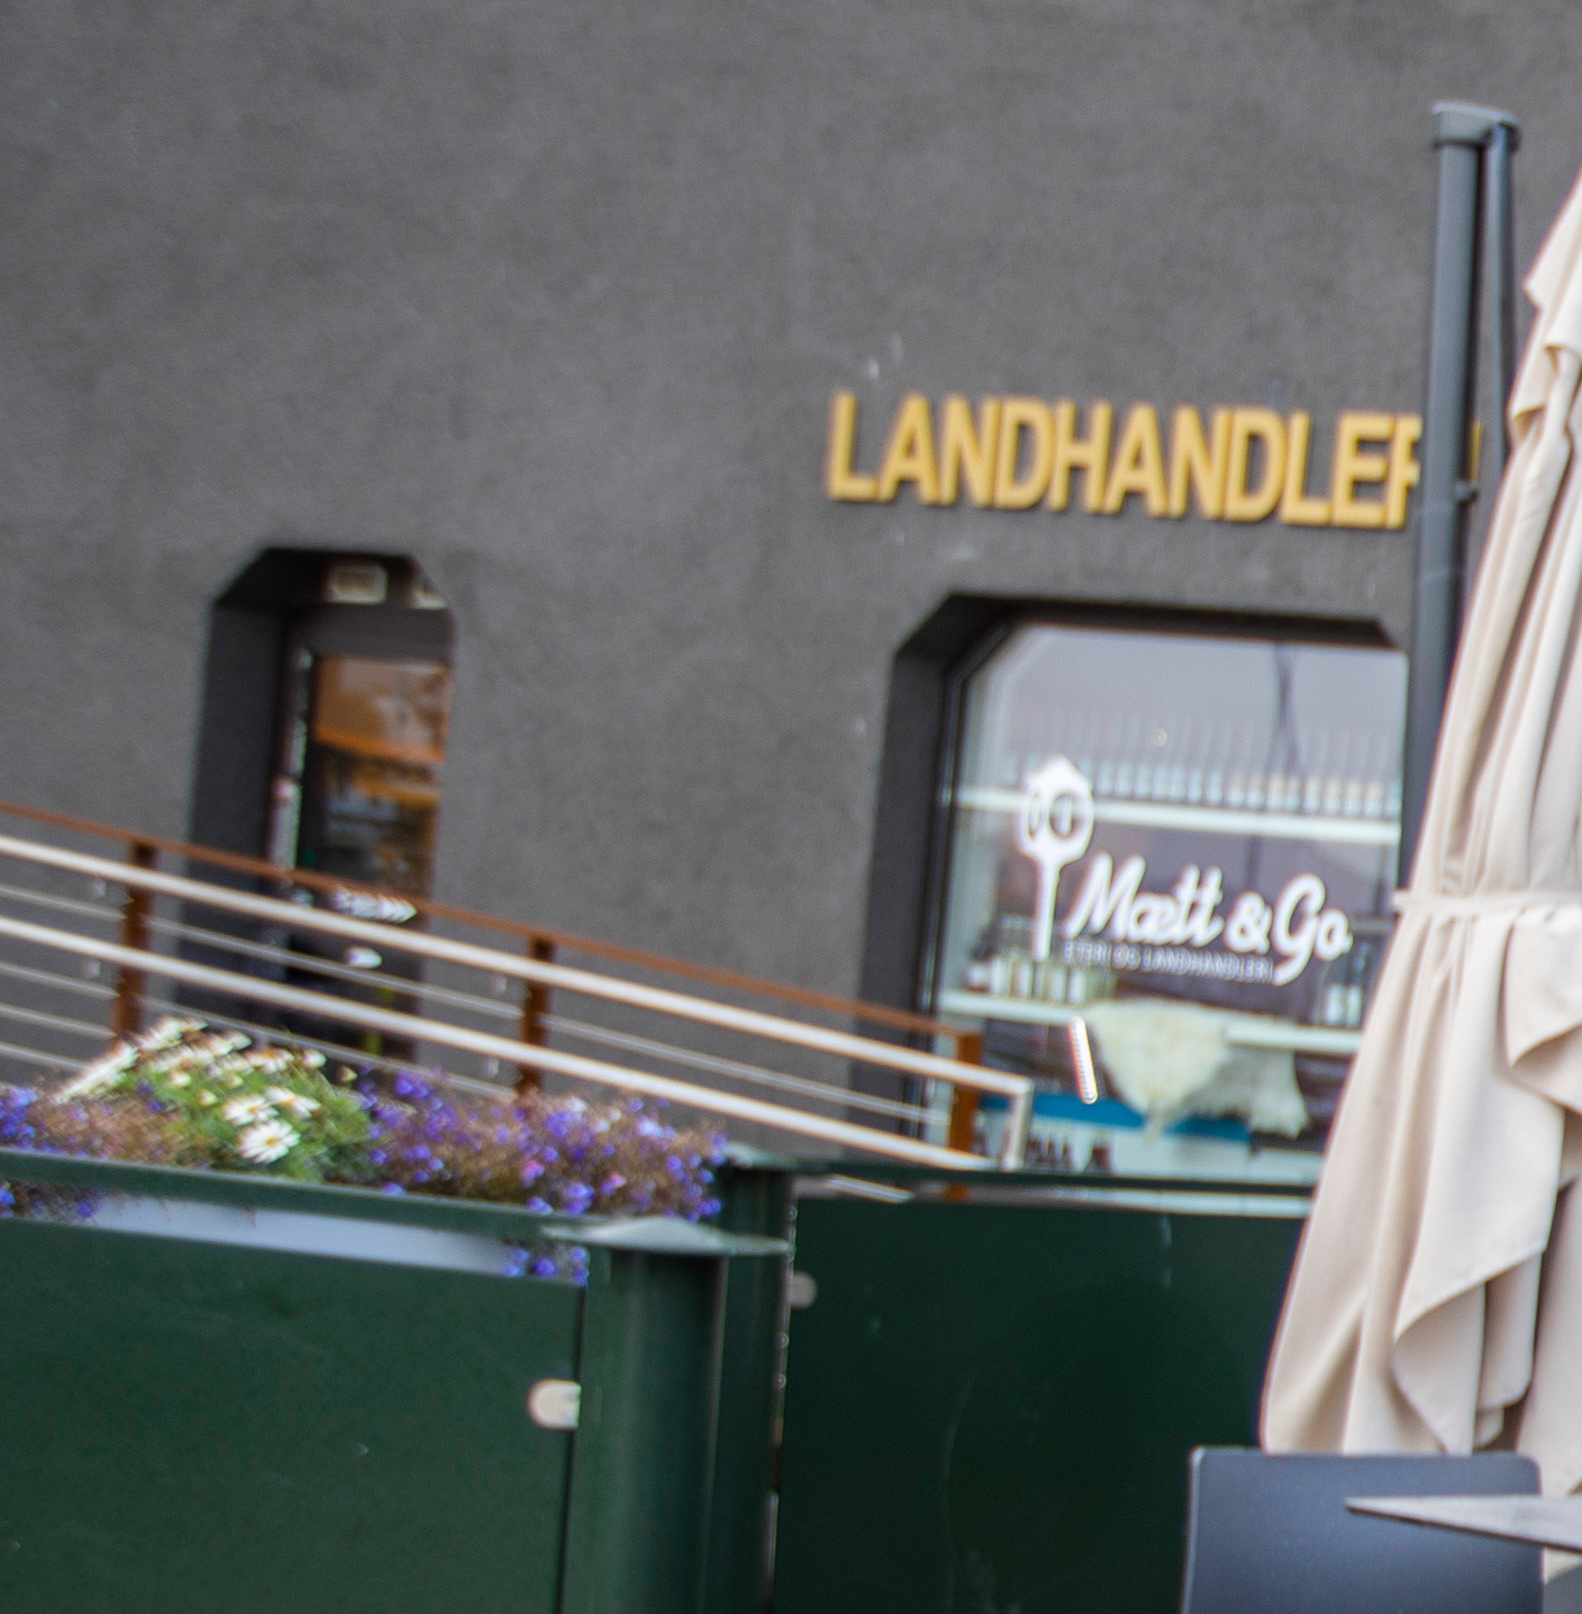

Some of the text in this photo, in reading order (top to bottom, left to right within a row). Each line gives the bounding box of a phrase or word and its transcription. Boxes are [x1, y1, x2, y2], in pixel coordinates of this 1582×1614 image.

[1061, 850, 1354, 986] Mætt & Go
